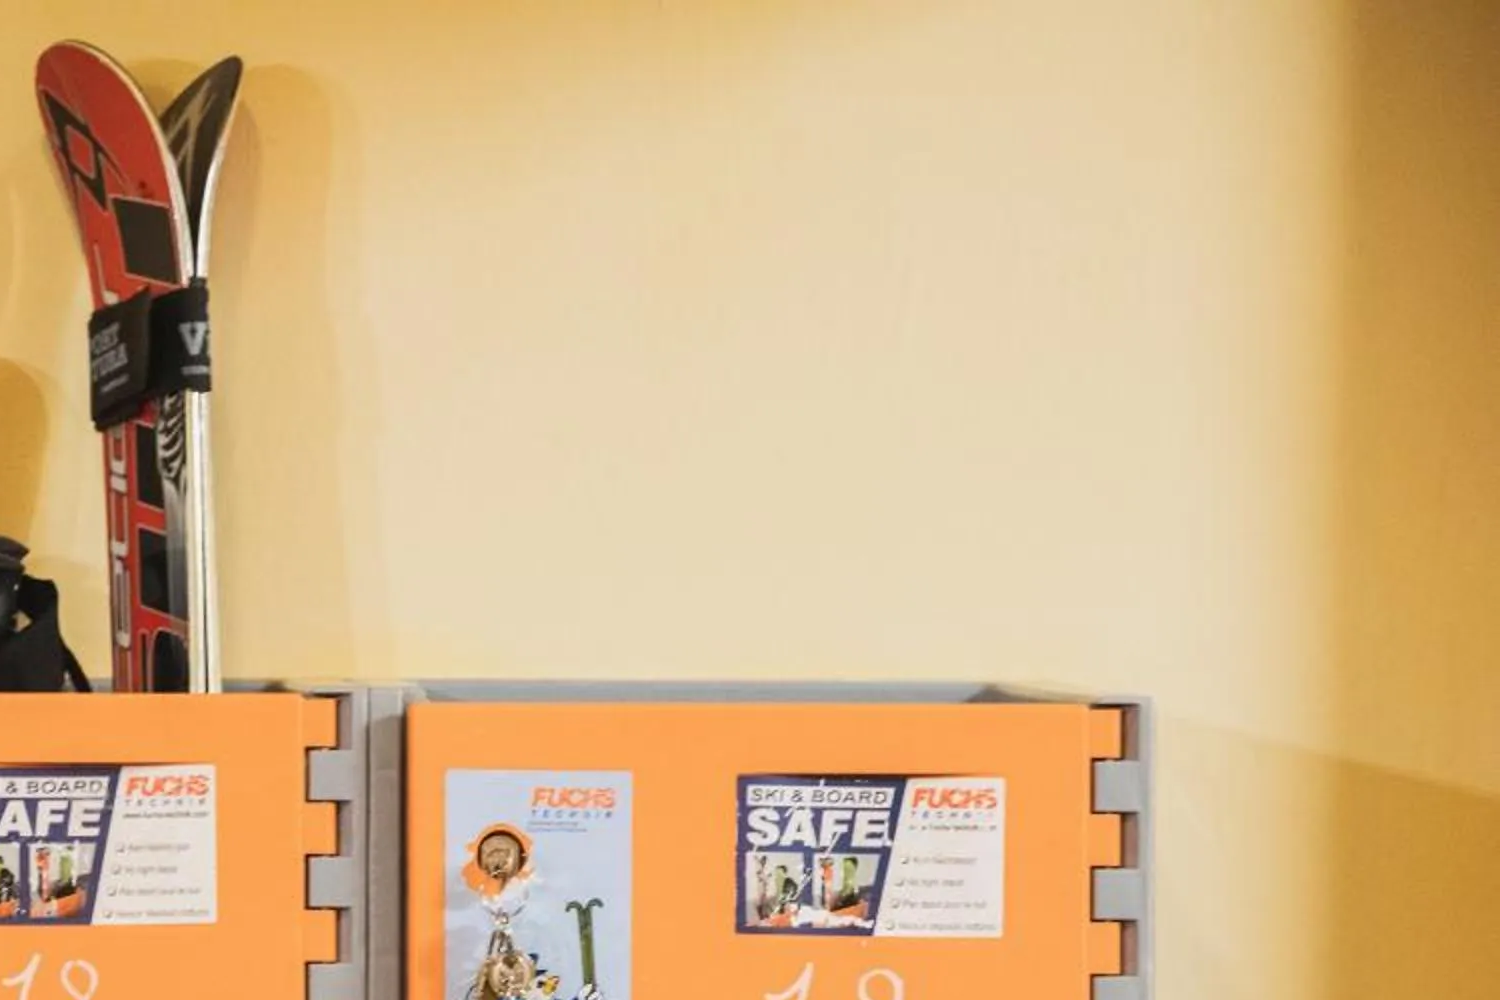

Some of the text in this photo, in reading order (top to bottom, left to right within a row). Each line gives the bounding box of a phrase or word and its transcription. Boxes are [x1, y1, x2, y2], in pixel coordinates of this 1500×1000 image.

[4, 779, 19, 794] &
[27, 779, 104, 795] BOARD
[126, 775, 211, 797] FUCHS
[750, 788, 889, 805] SKI & BOARD
[531, 786, 615, 809] FUCHS
[911, 787, 998, 810] FUCHS
[746, 808, 892, 848] SAFE
